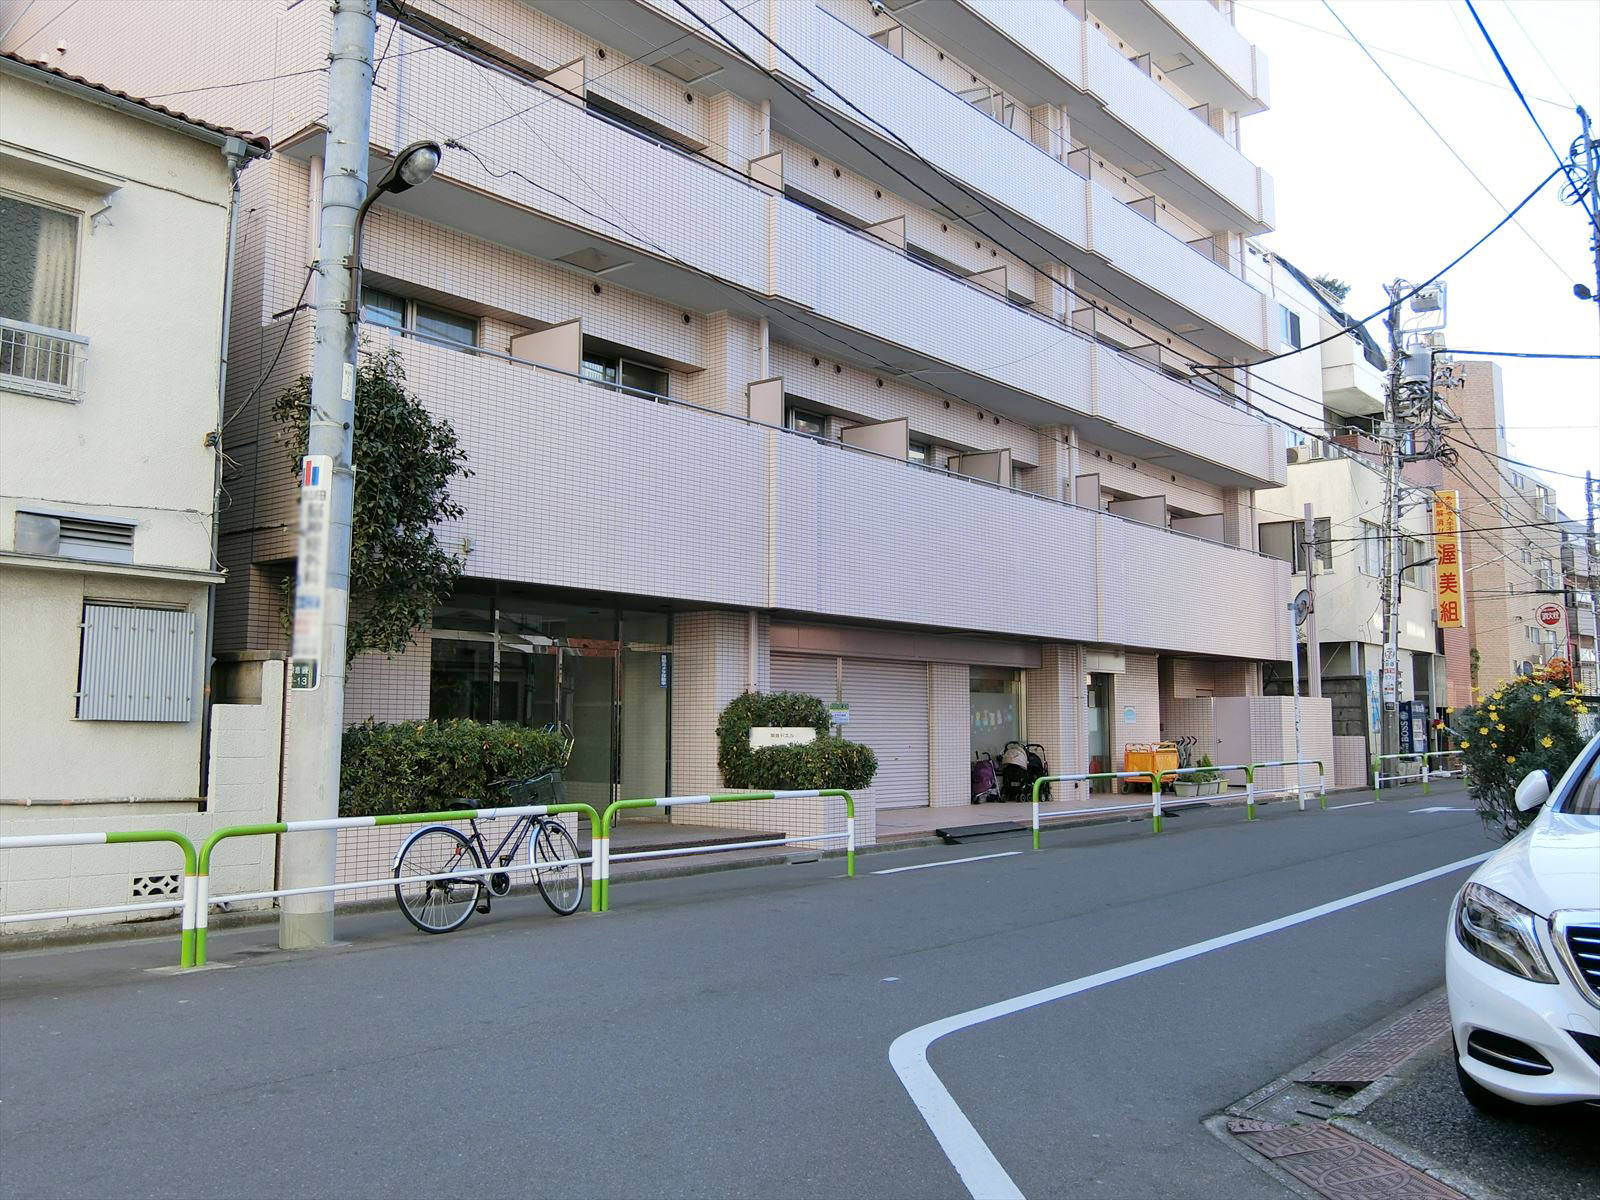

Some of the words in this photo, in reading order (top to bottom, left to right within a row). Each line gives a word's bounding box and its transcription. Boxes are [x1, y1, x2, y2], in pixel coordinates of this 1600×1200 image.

[1438, 543, 1459, 623] 渥美組
[1400, 720, 1409, 742] BOSS
